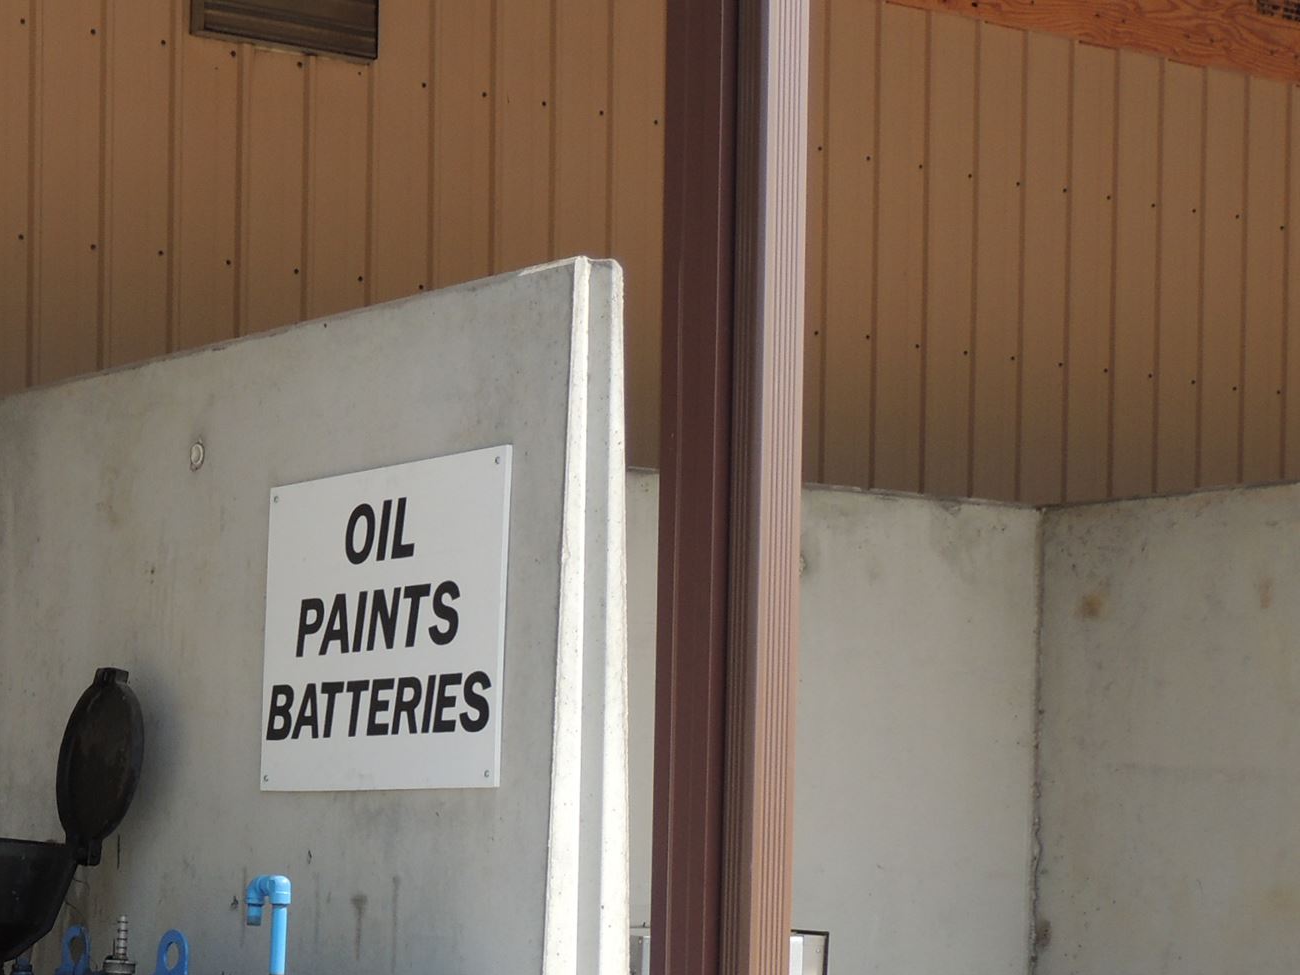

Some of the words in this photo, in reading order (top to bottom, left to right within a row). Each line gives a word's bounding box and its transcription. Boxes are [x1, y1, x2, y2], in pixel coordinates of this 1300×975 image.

[345, 497, 415, 565] OIL
[295, 580, 461, 658] PAINTS
[266, 670, 492, 740] BATTERIES
